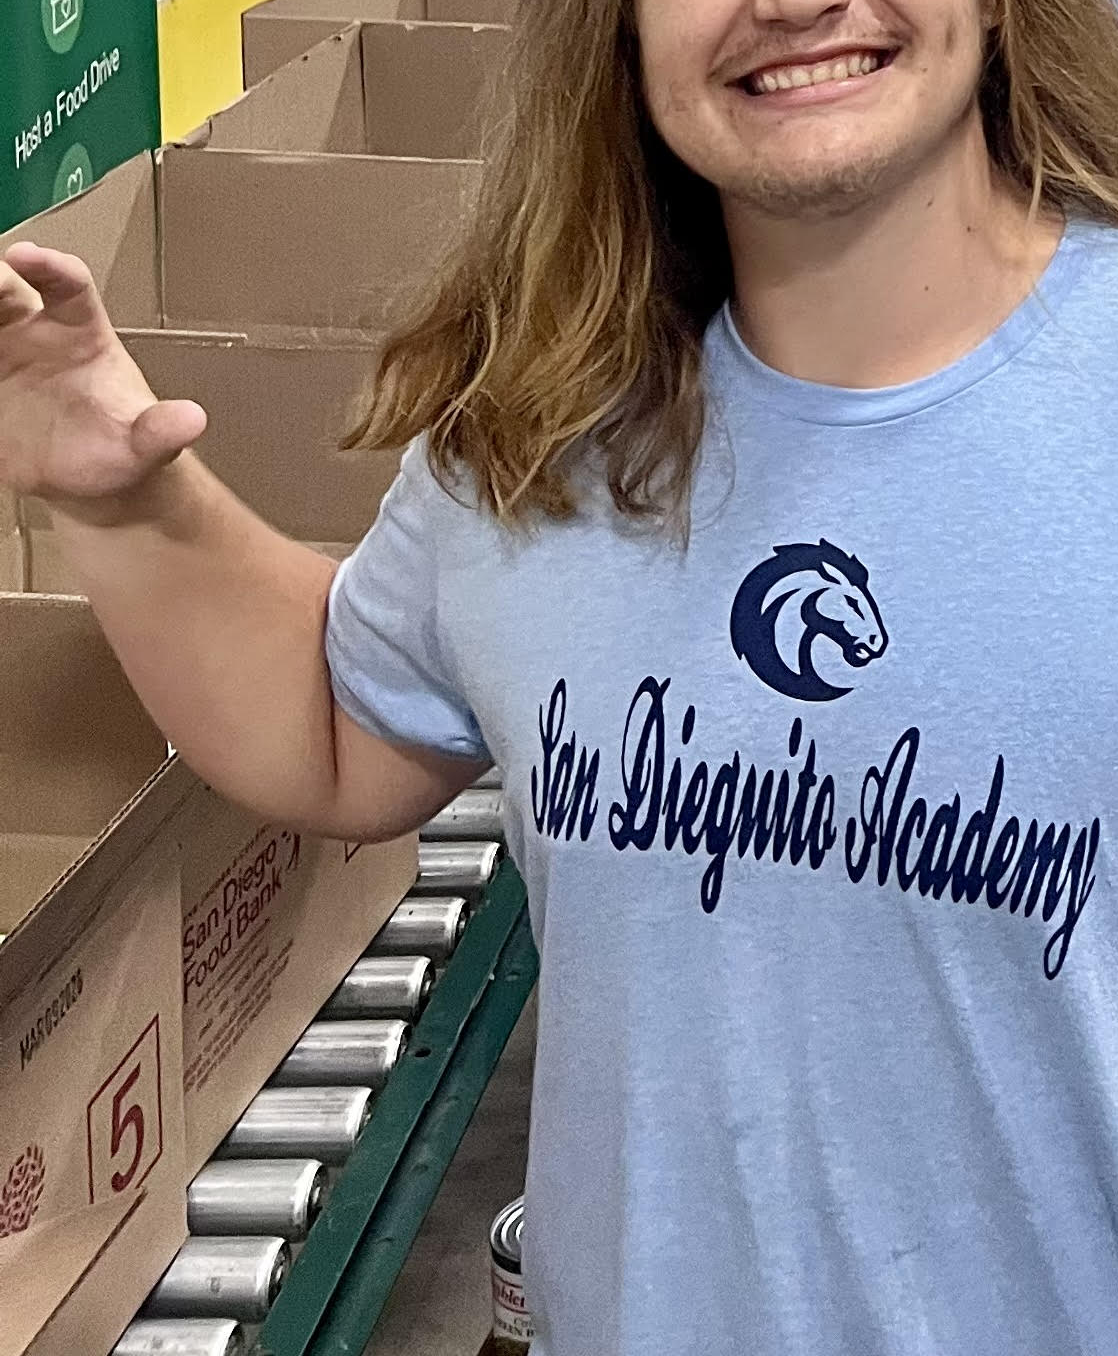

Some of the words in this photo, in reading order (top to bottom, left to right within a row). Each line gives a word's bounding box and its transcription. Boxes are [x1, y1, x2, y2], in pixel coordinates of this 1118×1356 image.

[15, 114, 42, 169] Host
[44, 110, 53, 137] a
[56, 70, 89, 126] Food
[90, 47, 120, 93] Drive
[531, 678, 600, 842] San
[608, 675, 837, 913] Dieguito
[846, 726, 1101, 980] Academy
[183, 907, 219, 963] San
[223, 839, 277, 918] Diego
[184, 919, 232, 1004] Food
[236, 866, 282, 939] Bank
[111, 1061, 144, 1192] 5
